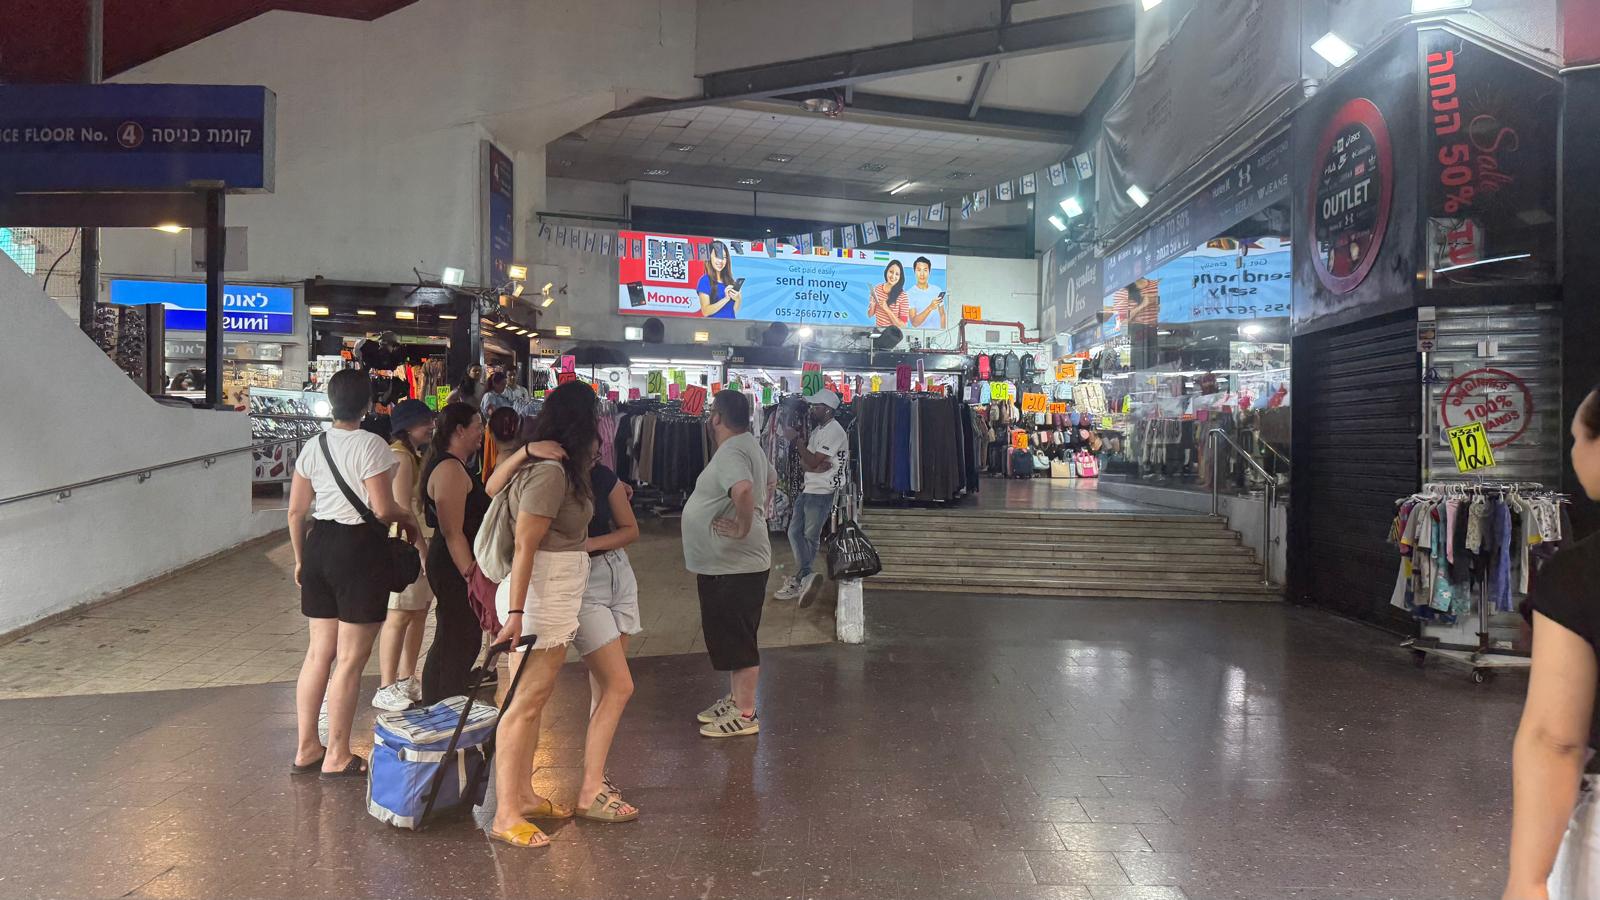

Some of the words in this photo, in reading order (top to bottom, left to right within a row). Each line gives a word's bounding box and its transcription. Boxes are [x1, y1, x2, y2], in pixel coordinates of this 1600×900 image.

[1427, 50, 1462, 137] הנחה
[24, 128, 75, 142] FLOOR
[81, 128, 108, 142] No.
[121, 127, 137, 144] 4
[152, 128, 200, 143] כניסה
[207, 128, 252, 147] קומת
[1469, 114, 1519, 193] Sale
[1437, 143, 1475, 213] 50%
[1322, 178, 1371, 221] OUTLET
[788, 265, 801, 273] Get
[802, 266, 816, 275] paid
[817, 266, 836, 277] easily
[776, 275, 804, 286] send
[808, 279, 848, 292] money
[223, 292, 269, 307] לאומ
[647, 291, 690, 305] Monox
[795, 290, 829, 304] safely
[775, 308, 832, 319] 055-2666777
[222, 315, 269, 330] eumi
[648, 371, 661, 393] 30
[1463, 395, 1513, 421] 100%
[1458, 434, 1487, 470] 12
